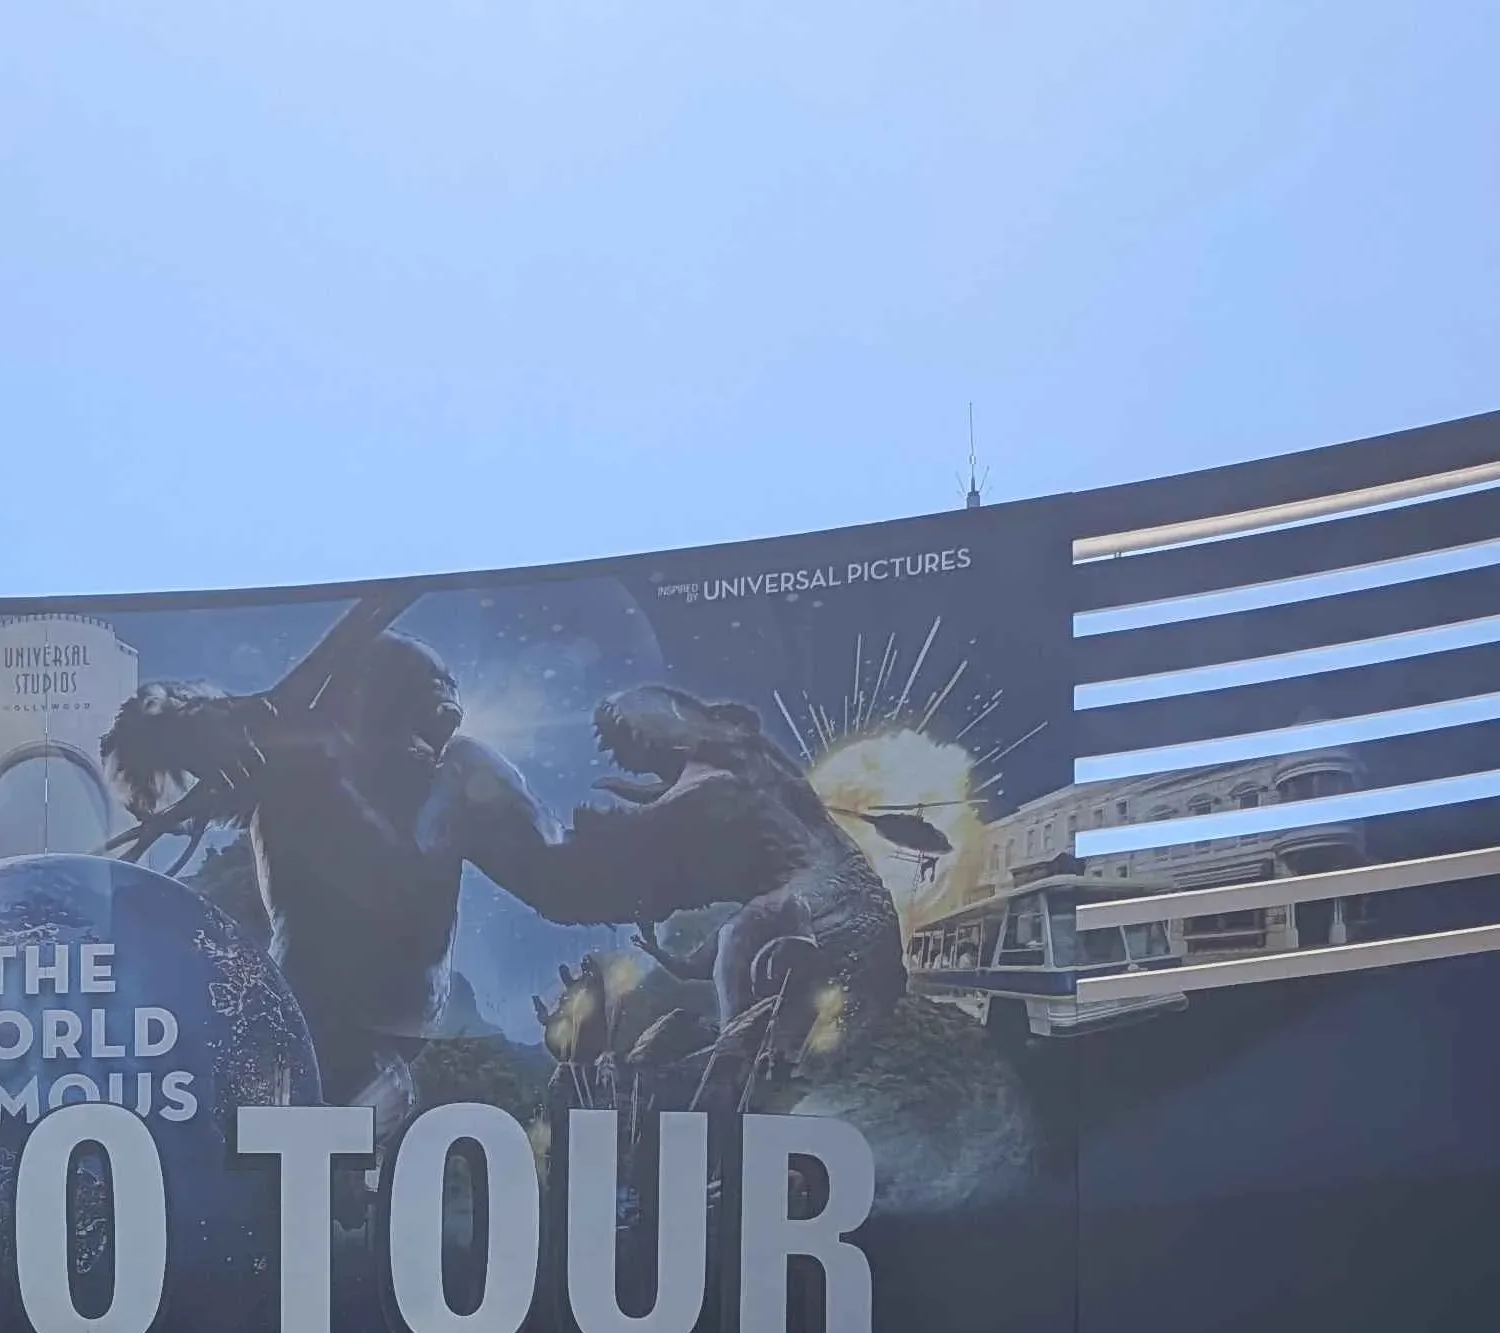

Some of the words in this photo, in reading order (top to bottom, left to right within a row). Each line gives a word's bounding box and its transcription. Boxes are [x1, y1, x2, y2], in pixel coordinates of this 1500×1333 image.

[703, 566, 841, 601] UNIVERSAL
[847, 547, 972, 585] PICTURES
[657, 583, 699, 598] INSPIRED
[687, 593, 699, 603] BY
[4, 644, 91, 669] UNIVERSAL
[14, 671, 78, 696] STUDIOS
